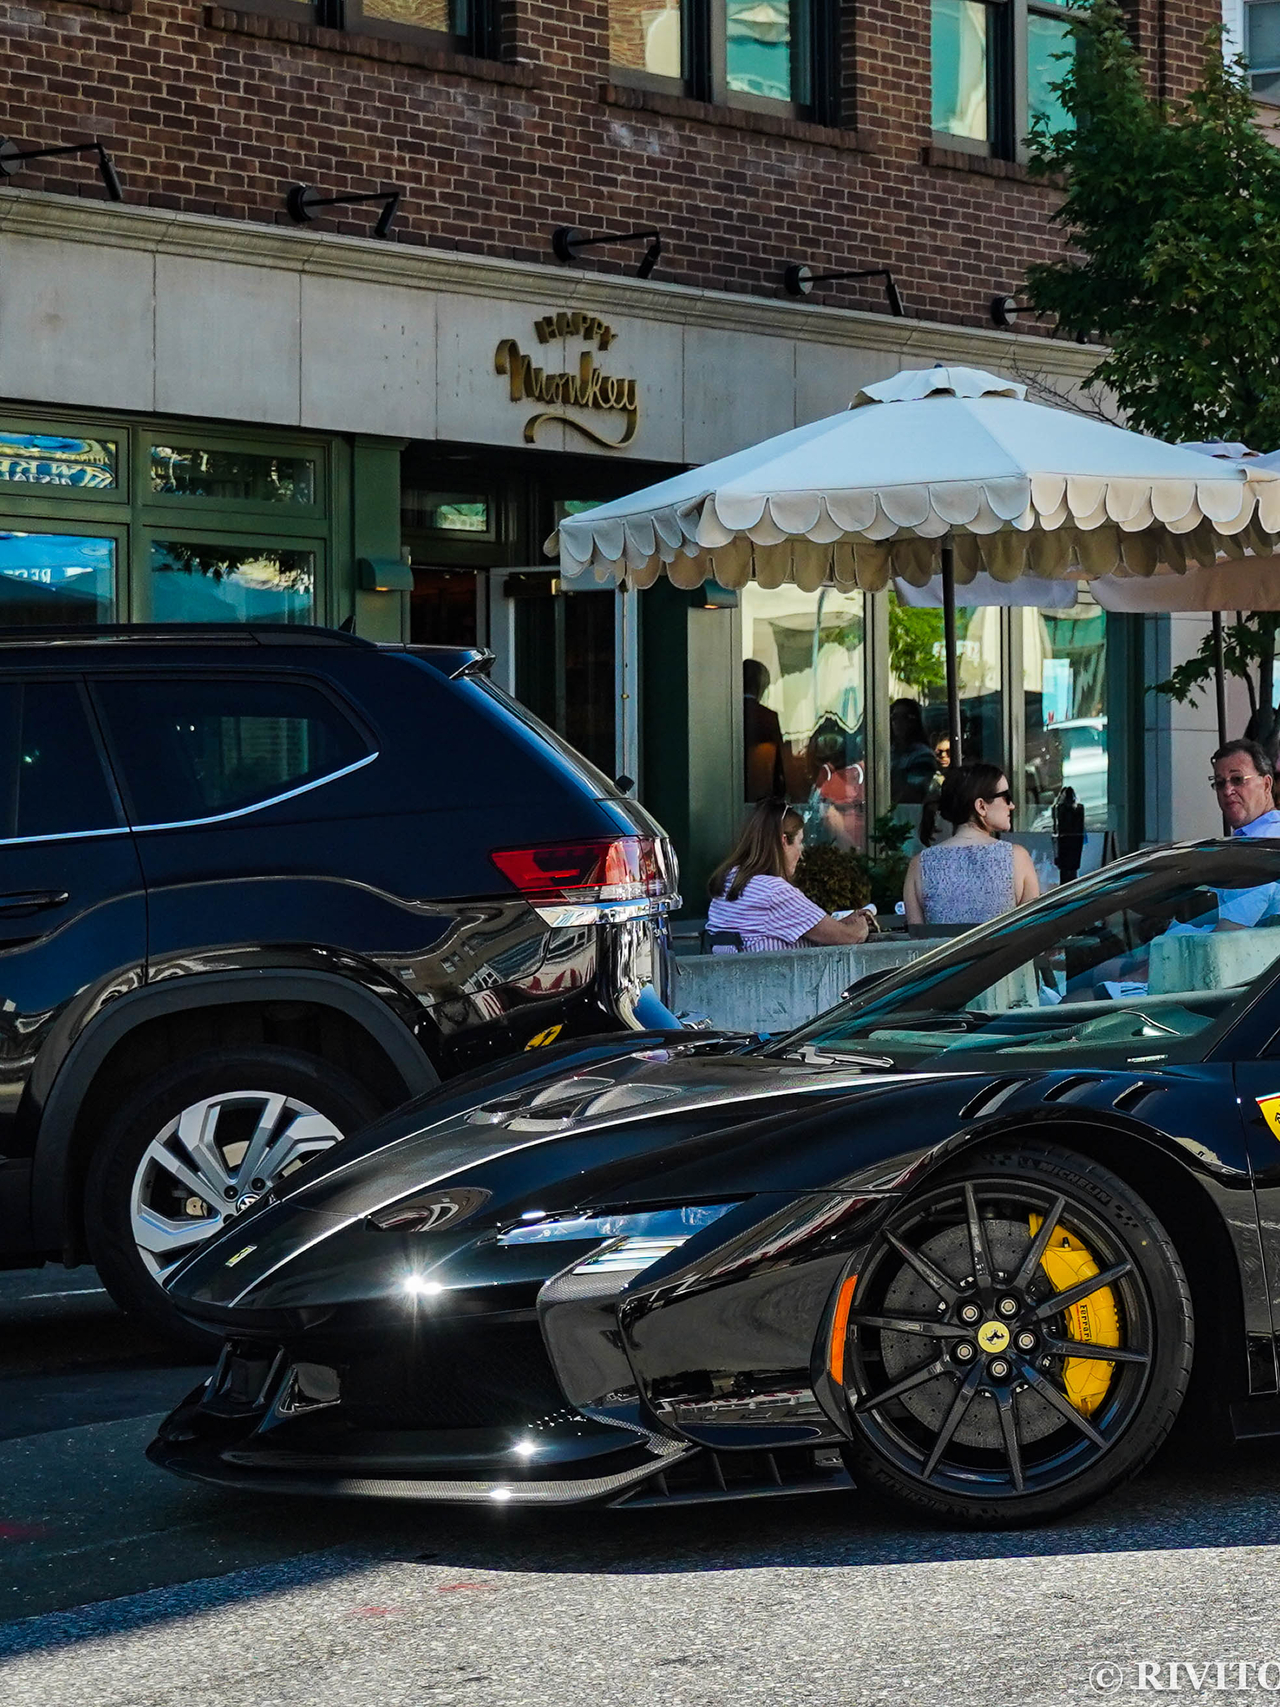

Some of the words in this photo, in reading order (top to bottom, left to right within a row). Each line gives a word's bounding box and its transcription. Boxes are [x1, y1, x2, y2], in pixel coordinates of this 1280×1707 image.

[534, 312, 618, 351] HAPPY
[495, 339, 639, 449] Monkey
[1037, 1160, 1113, 1207] MICHELIN
